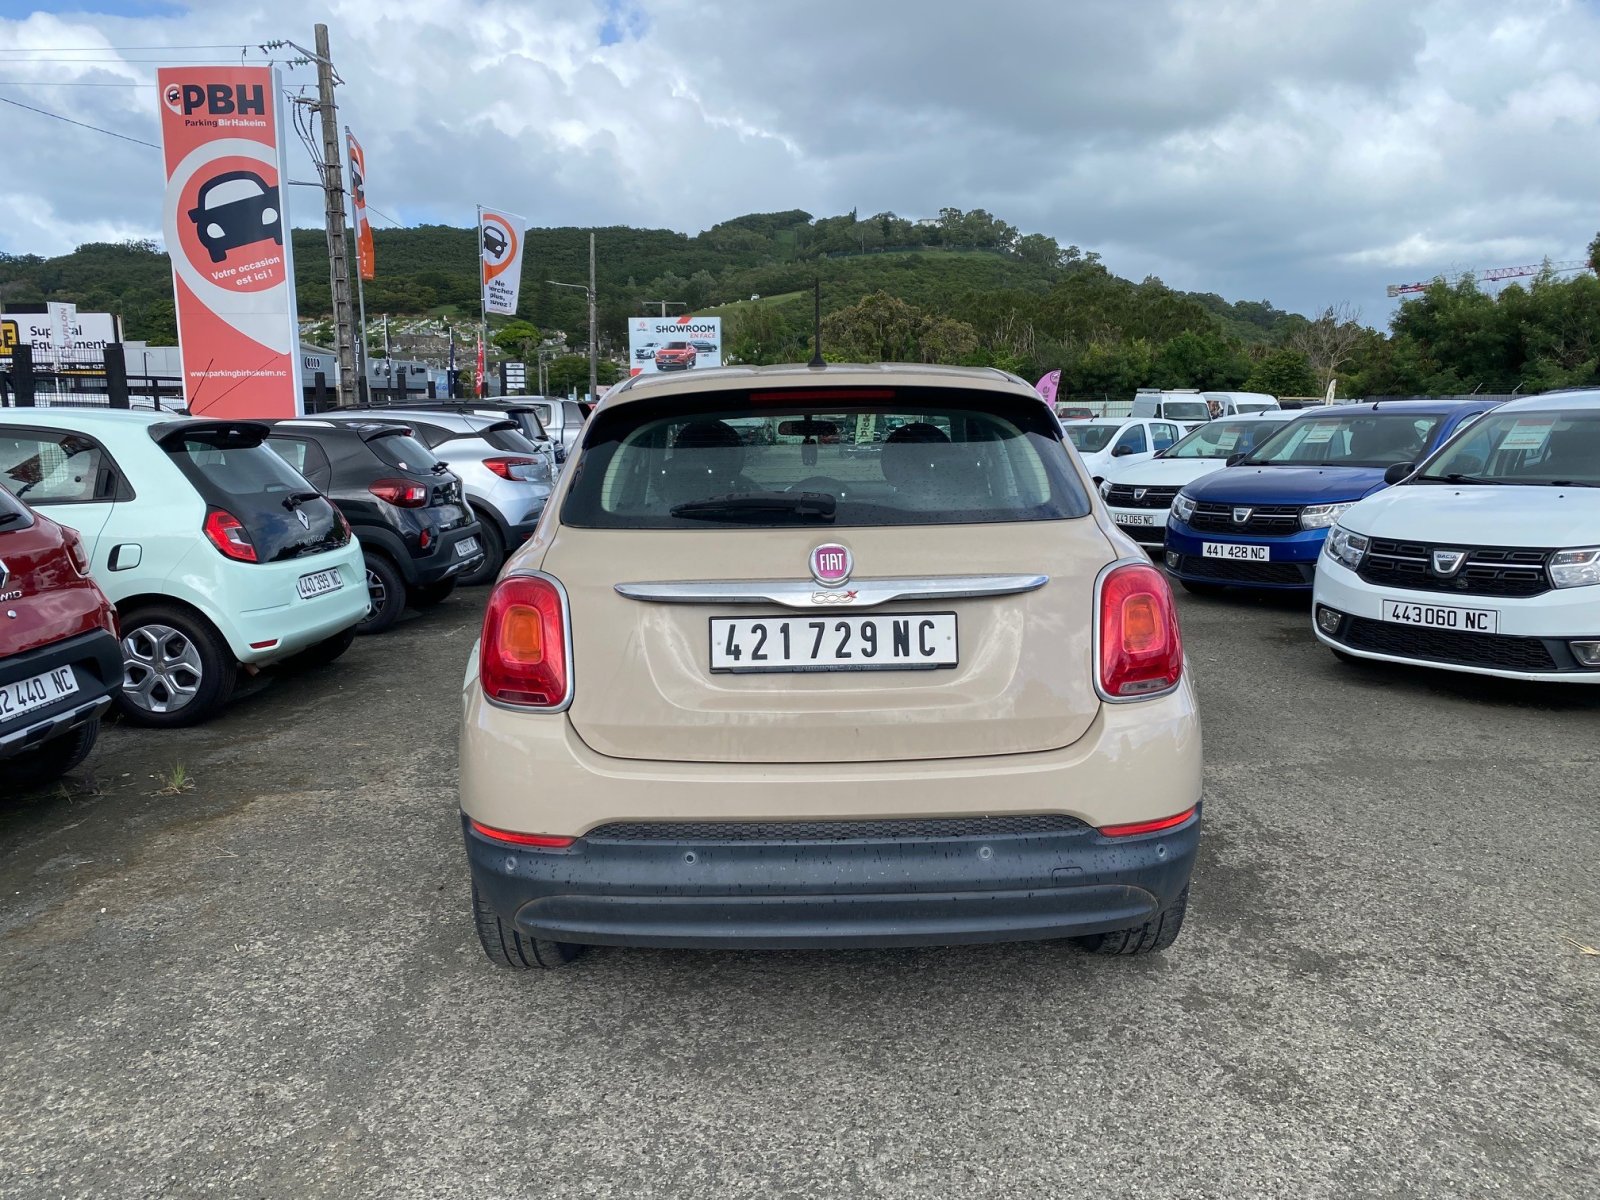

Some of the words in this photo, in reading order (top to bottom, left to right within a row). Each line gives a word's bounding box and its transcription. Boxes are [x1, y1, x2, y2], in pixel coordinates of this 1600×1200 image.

[182, 84, 265, 115] PBH
[211, 268, 237, 280] Votre
[238, 256, 280, 273] occasion
[235, 275, 253, 286] est
[253, 270, 268, 281] ici
[268, 268, 273, 277] !
[490, 292, 505, 301] plus,
[656, 325, 715, 333] SHOWROOM
[189, 369, 287, 378] www.parkingbirhakeim.nc
[1115, 513, 1128, 523] 443
[1129, 515, 1143, 525] 065
[1206, 544, 1224, 557] 441
[1228, 546, 1248, 559] 428
[1250, 548, 1266, 560] NC
[820, 553, 844, 571] FIAT
[300, 577, 316, 594] 440
[314, 573, 330, 590] 399
[330, 570, 341, 585] NC
[1392, 604, 1422, 623] 443
[1425, 608, 1457, 627] 060
[1465, 611, 1488, 630] NC
[725, 622, 791, 661] 421
[808, 621, 877, 659] 729
[893, 620, 936, 657] NC
[0, 689, 14, 715] 2
[16, 677, 47, 706] 440
[51, 668, 73, 694] NC
